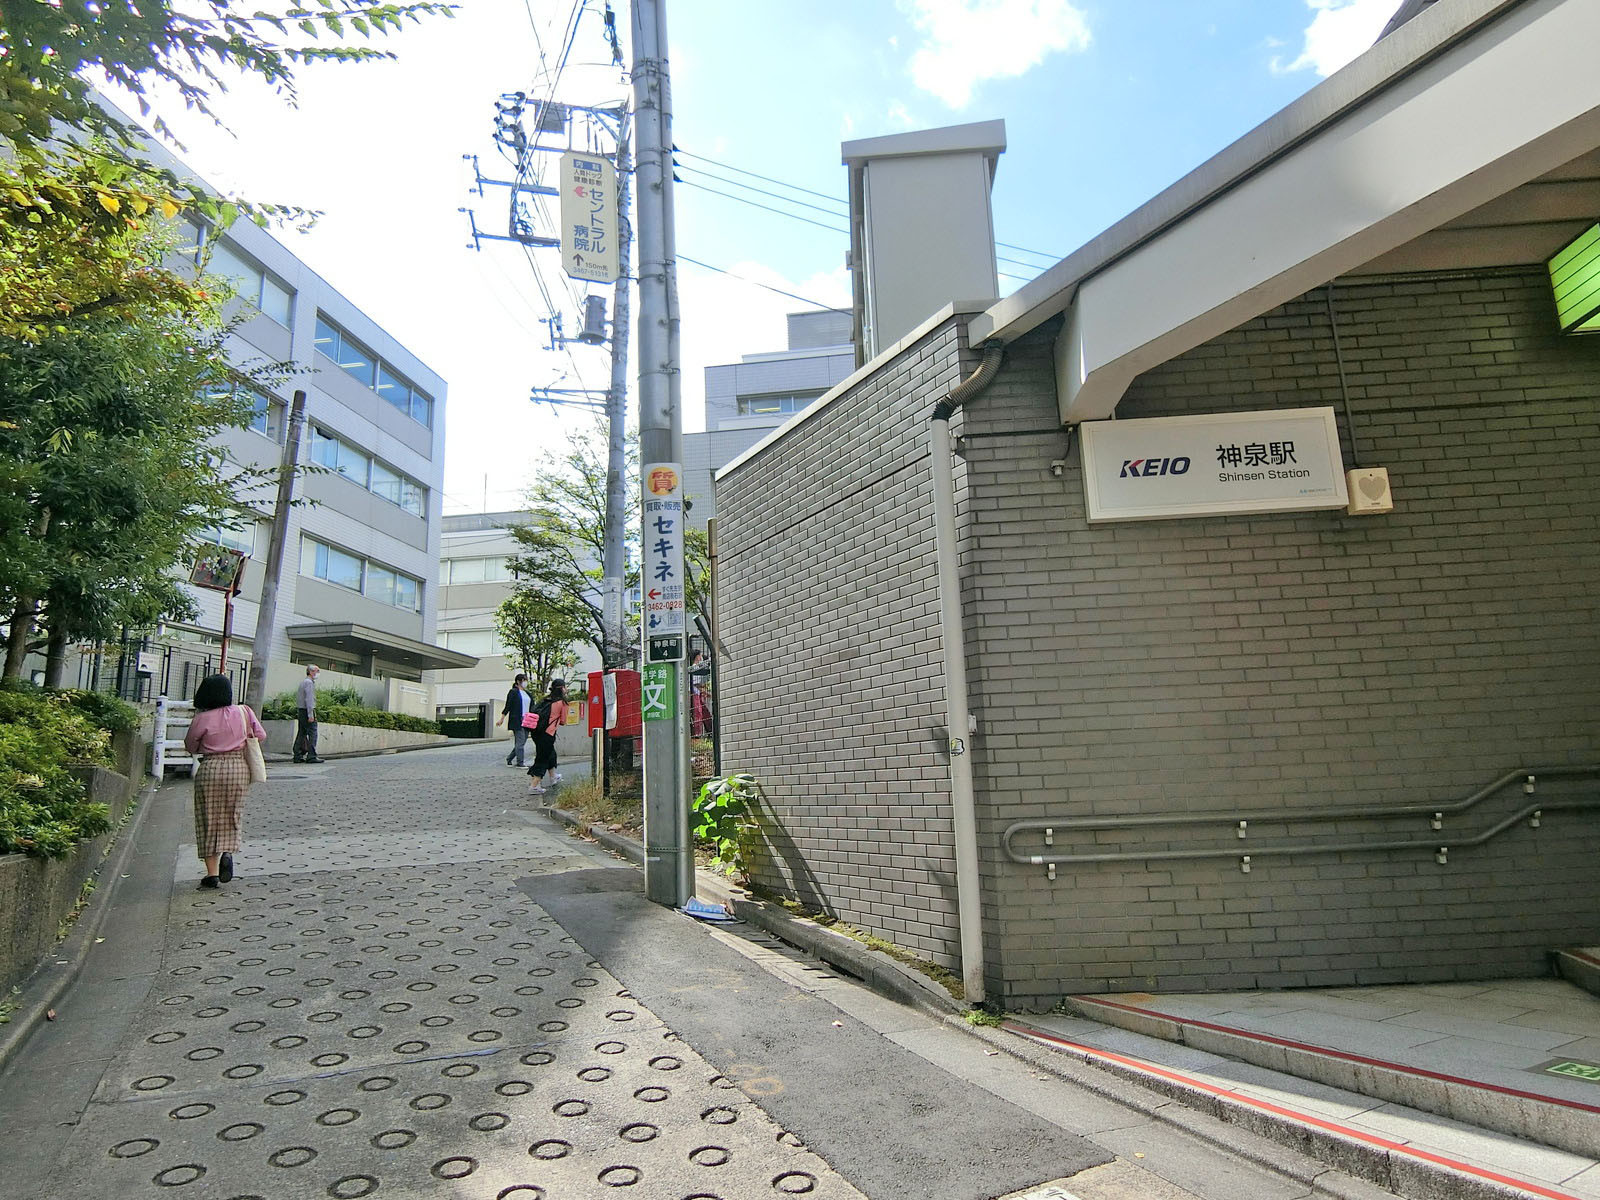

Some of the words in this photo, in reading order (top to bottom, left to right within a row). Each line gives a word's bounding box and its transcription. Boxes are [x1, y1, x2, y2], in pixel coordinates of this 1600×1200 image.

[574, 169, 602, 180] 人間ドック
[589, 188, 606, 253] セントラル
[573, 224, 589, 252] 病院
[1215, 441, 1297, 468] 神泉駅
[1119, 457, 1191, 478] KEIO
[1218, 472, 1265, 482] Shinsen
[1268, 469, 1310, 480] Station
[651, 470, 675, 493] 質
[646, 501, 682, 512] 買取・販売
[653, 516, 674, 582] セキネ
[654, 639, 677, 648] 神泉町
[643, 680, 666, 711] 文
